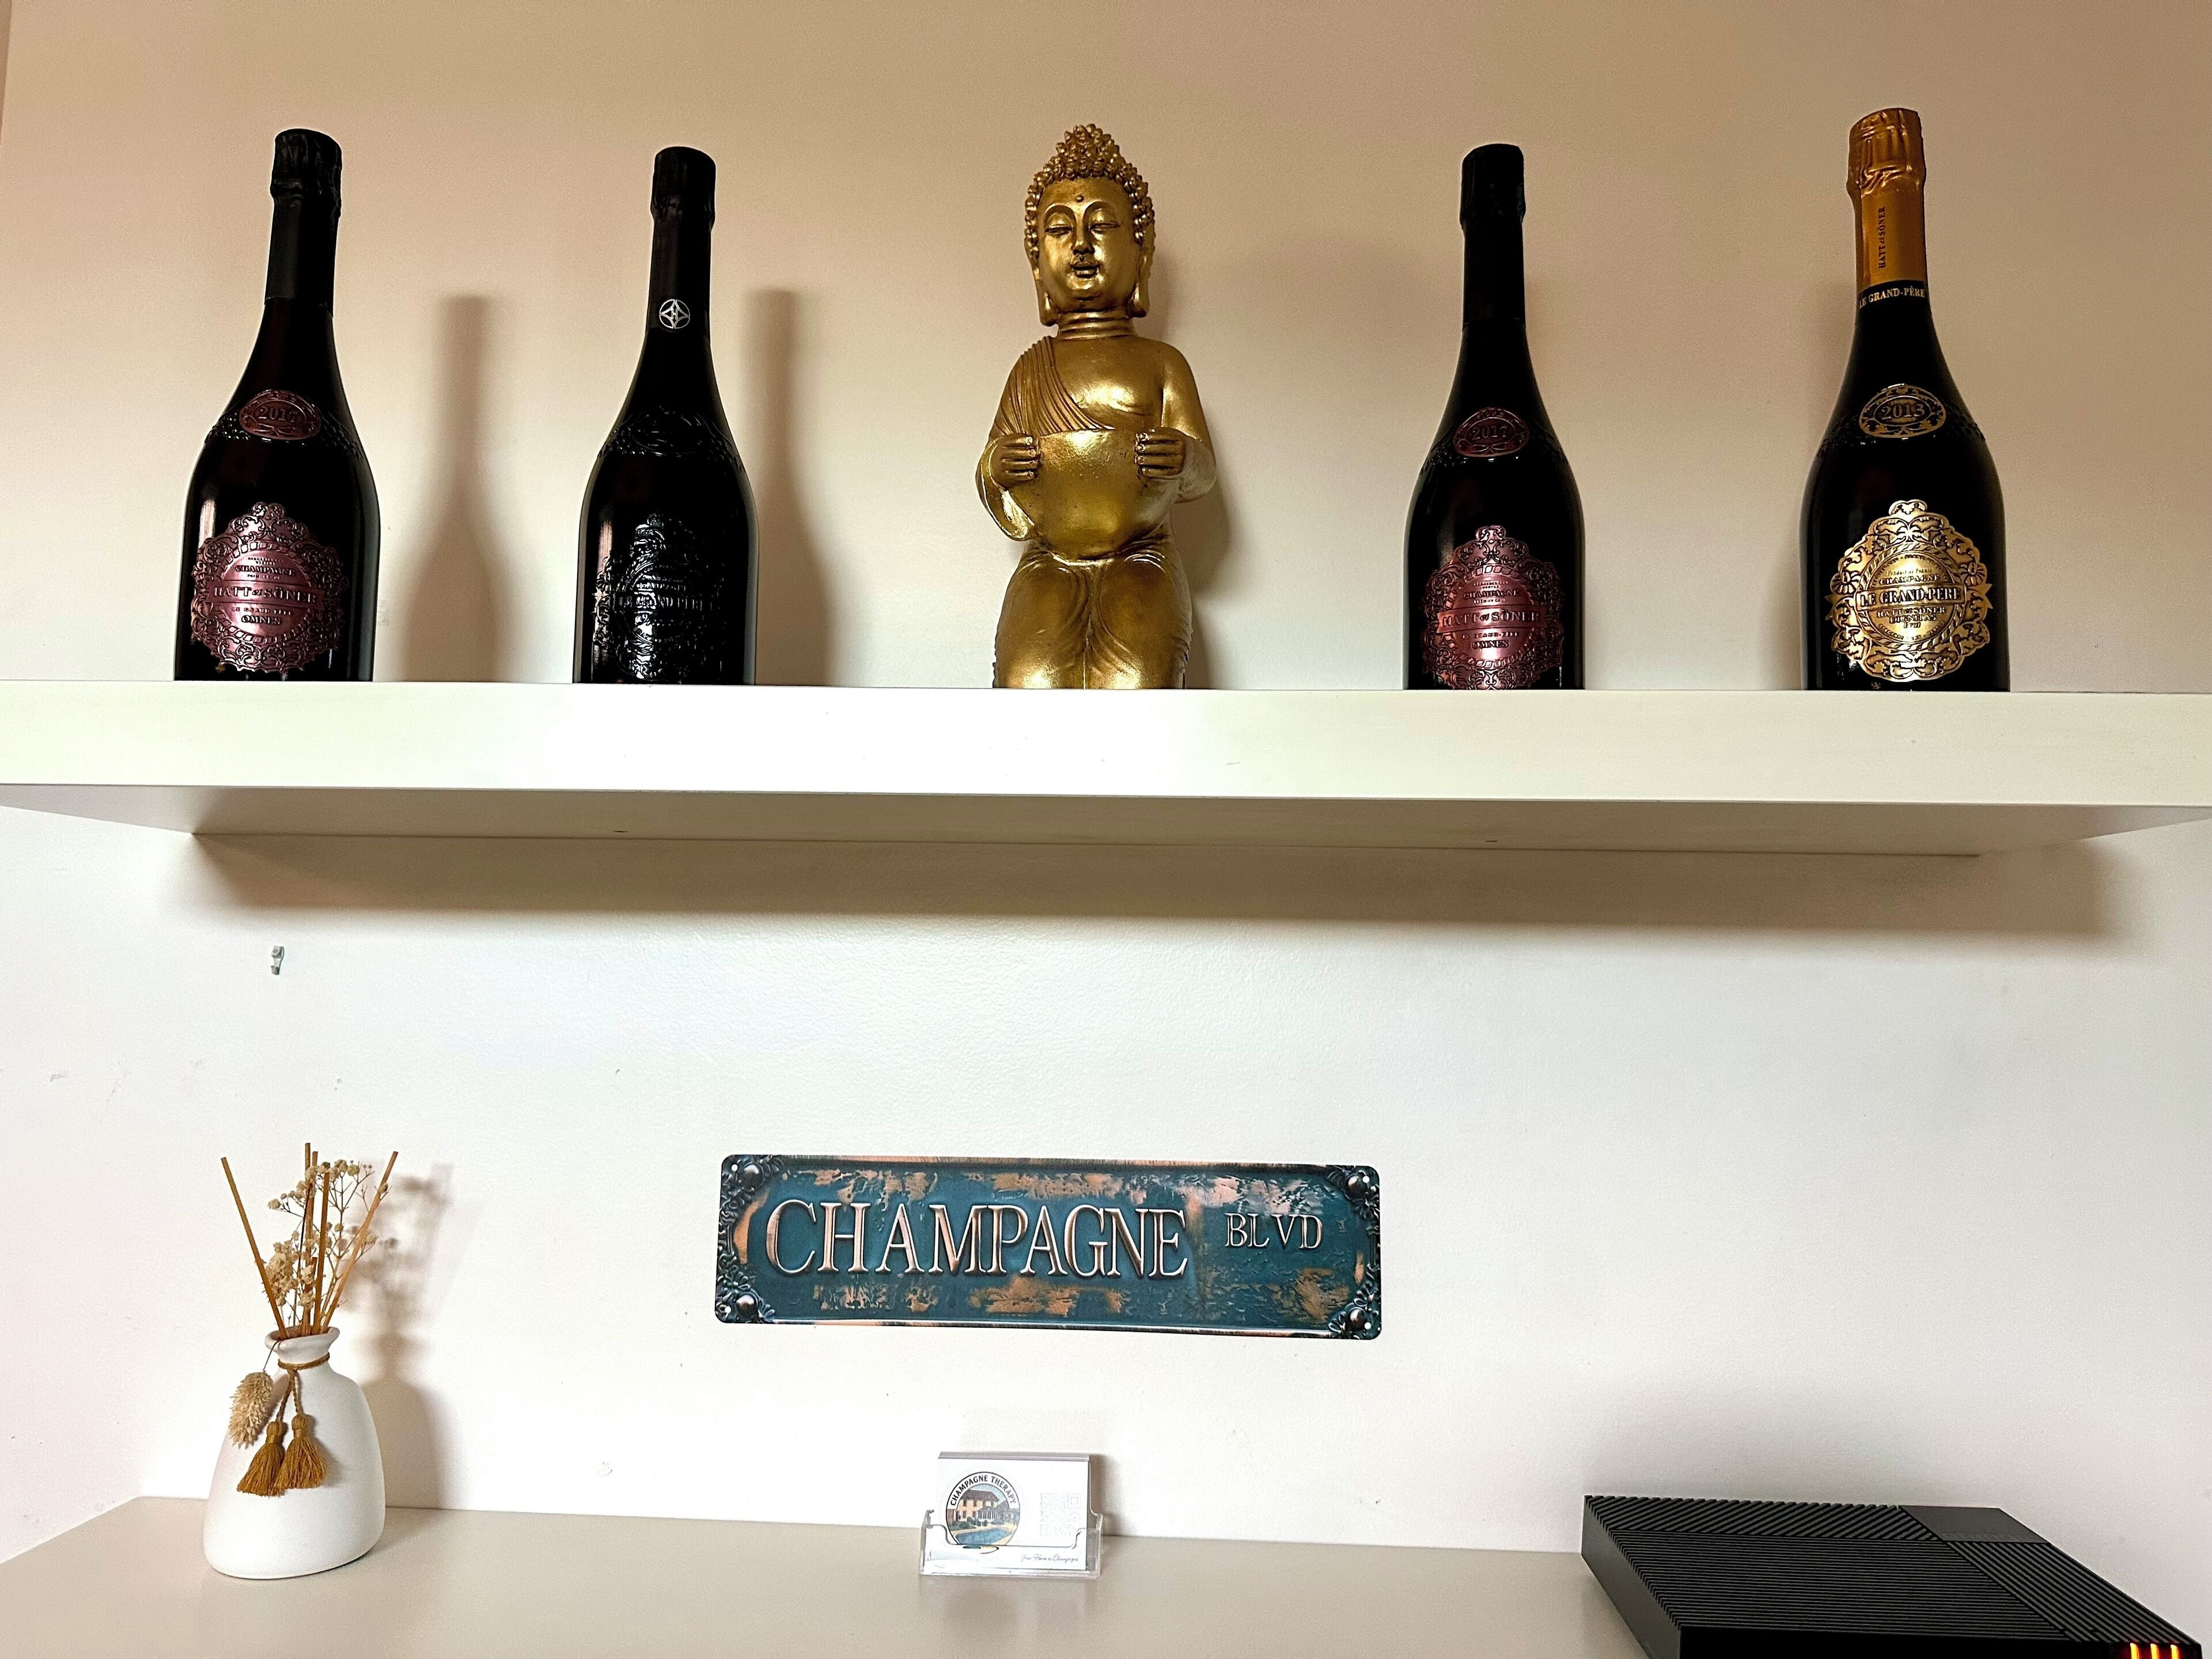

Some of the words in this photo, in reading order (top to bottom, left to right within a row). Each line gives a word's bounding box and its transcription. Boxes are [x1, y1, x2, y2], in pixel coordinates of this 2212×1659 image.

[1878, 244, 1886, 269] HATT
[1859, 297, 1867, 309] LE
[258, 406, 298, 423] 2017
[1881, 404, 1925, 421] 2013
[1471, 426, 1508, 440] 2017
[234, 565, 296, 575] CHAMPAGNE
[1878, 574, 1940, 585] CHAMPAGNE
[214, 586, 252, 597] HATT
[264, 586, 316, 603] SÖNER
[1463, 589, 1520, 600] CHAMPAGNE
[1860, 593, 1876, 607] LE
[241, 615, 282, 626] OMNES
[1443, 612, 1480, 627] HATT
[765, 1199, 1188, 1278] CHAMPAGNE
[1224, 1213, 1323, 1249] BLVD
[950, 1475, 988, 1506] CHAMPAGNE
[991, 1476, 1017, 1503] THERAPY
